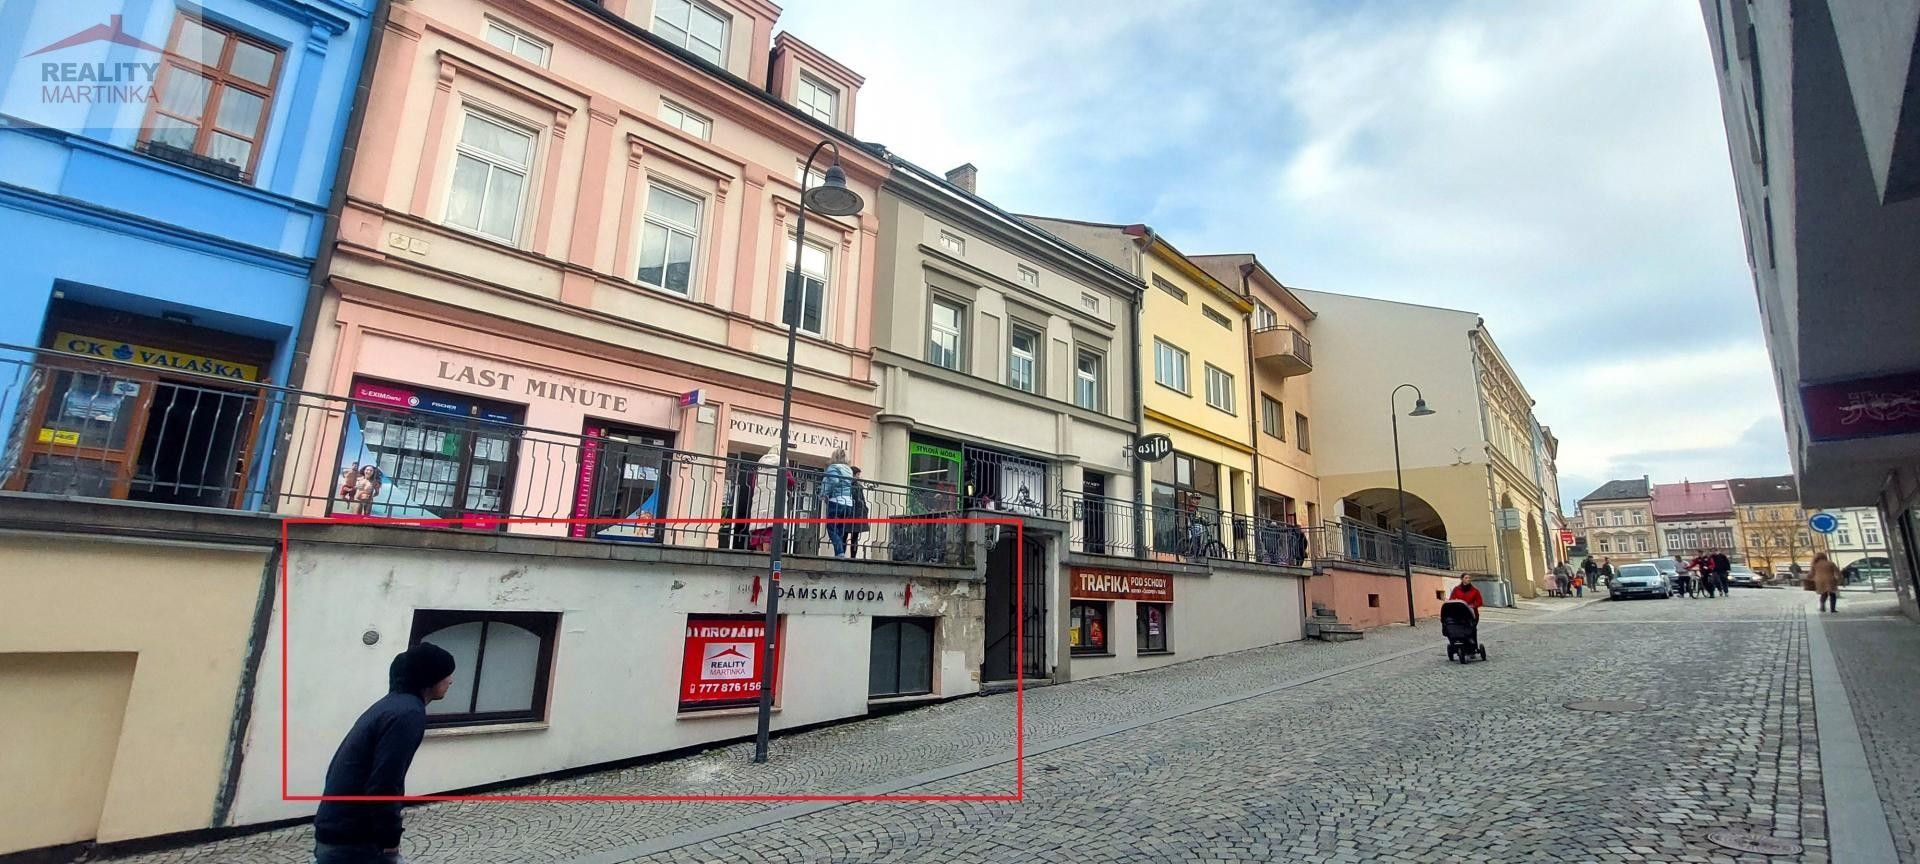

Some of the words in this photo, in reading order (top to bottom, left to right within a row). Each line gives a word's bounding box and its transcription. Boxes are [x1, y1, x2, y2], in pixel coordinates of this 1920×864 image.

[68, 339, 105, 356] CK
[140, 351, 243, 378] VALAŠKA
[438, 361, 514, 390] LAST
[526, 379, 627, 412] MINUTE
[1080, 574, 1129, 592] TRAFIKA
[1130, 576, 1144, 587] POD
[1144, 577, 1167, 588] SCHODY
[778, 585, 838, 599] DÁMSKÁ
[844, 589, 885, 601] MÓDA
[709, 668, 746, 676] MARTINKA
[710, 660, 746, 669] REALITY
[699, 683, 720, 693] 777
[720, 682, 741, 692] 876
[742, 681, 762, 692] 156
